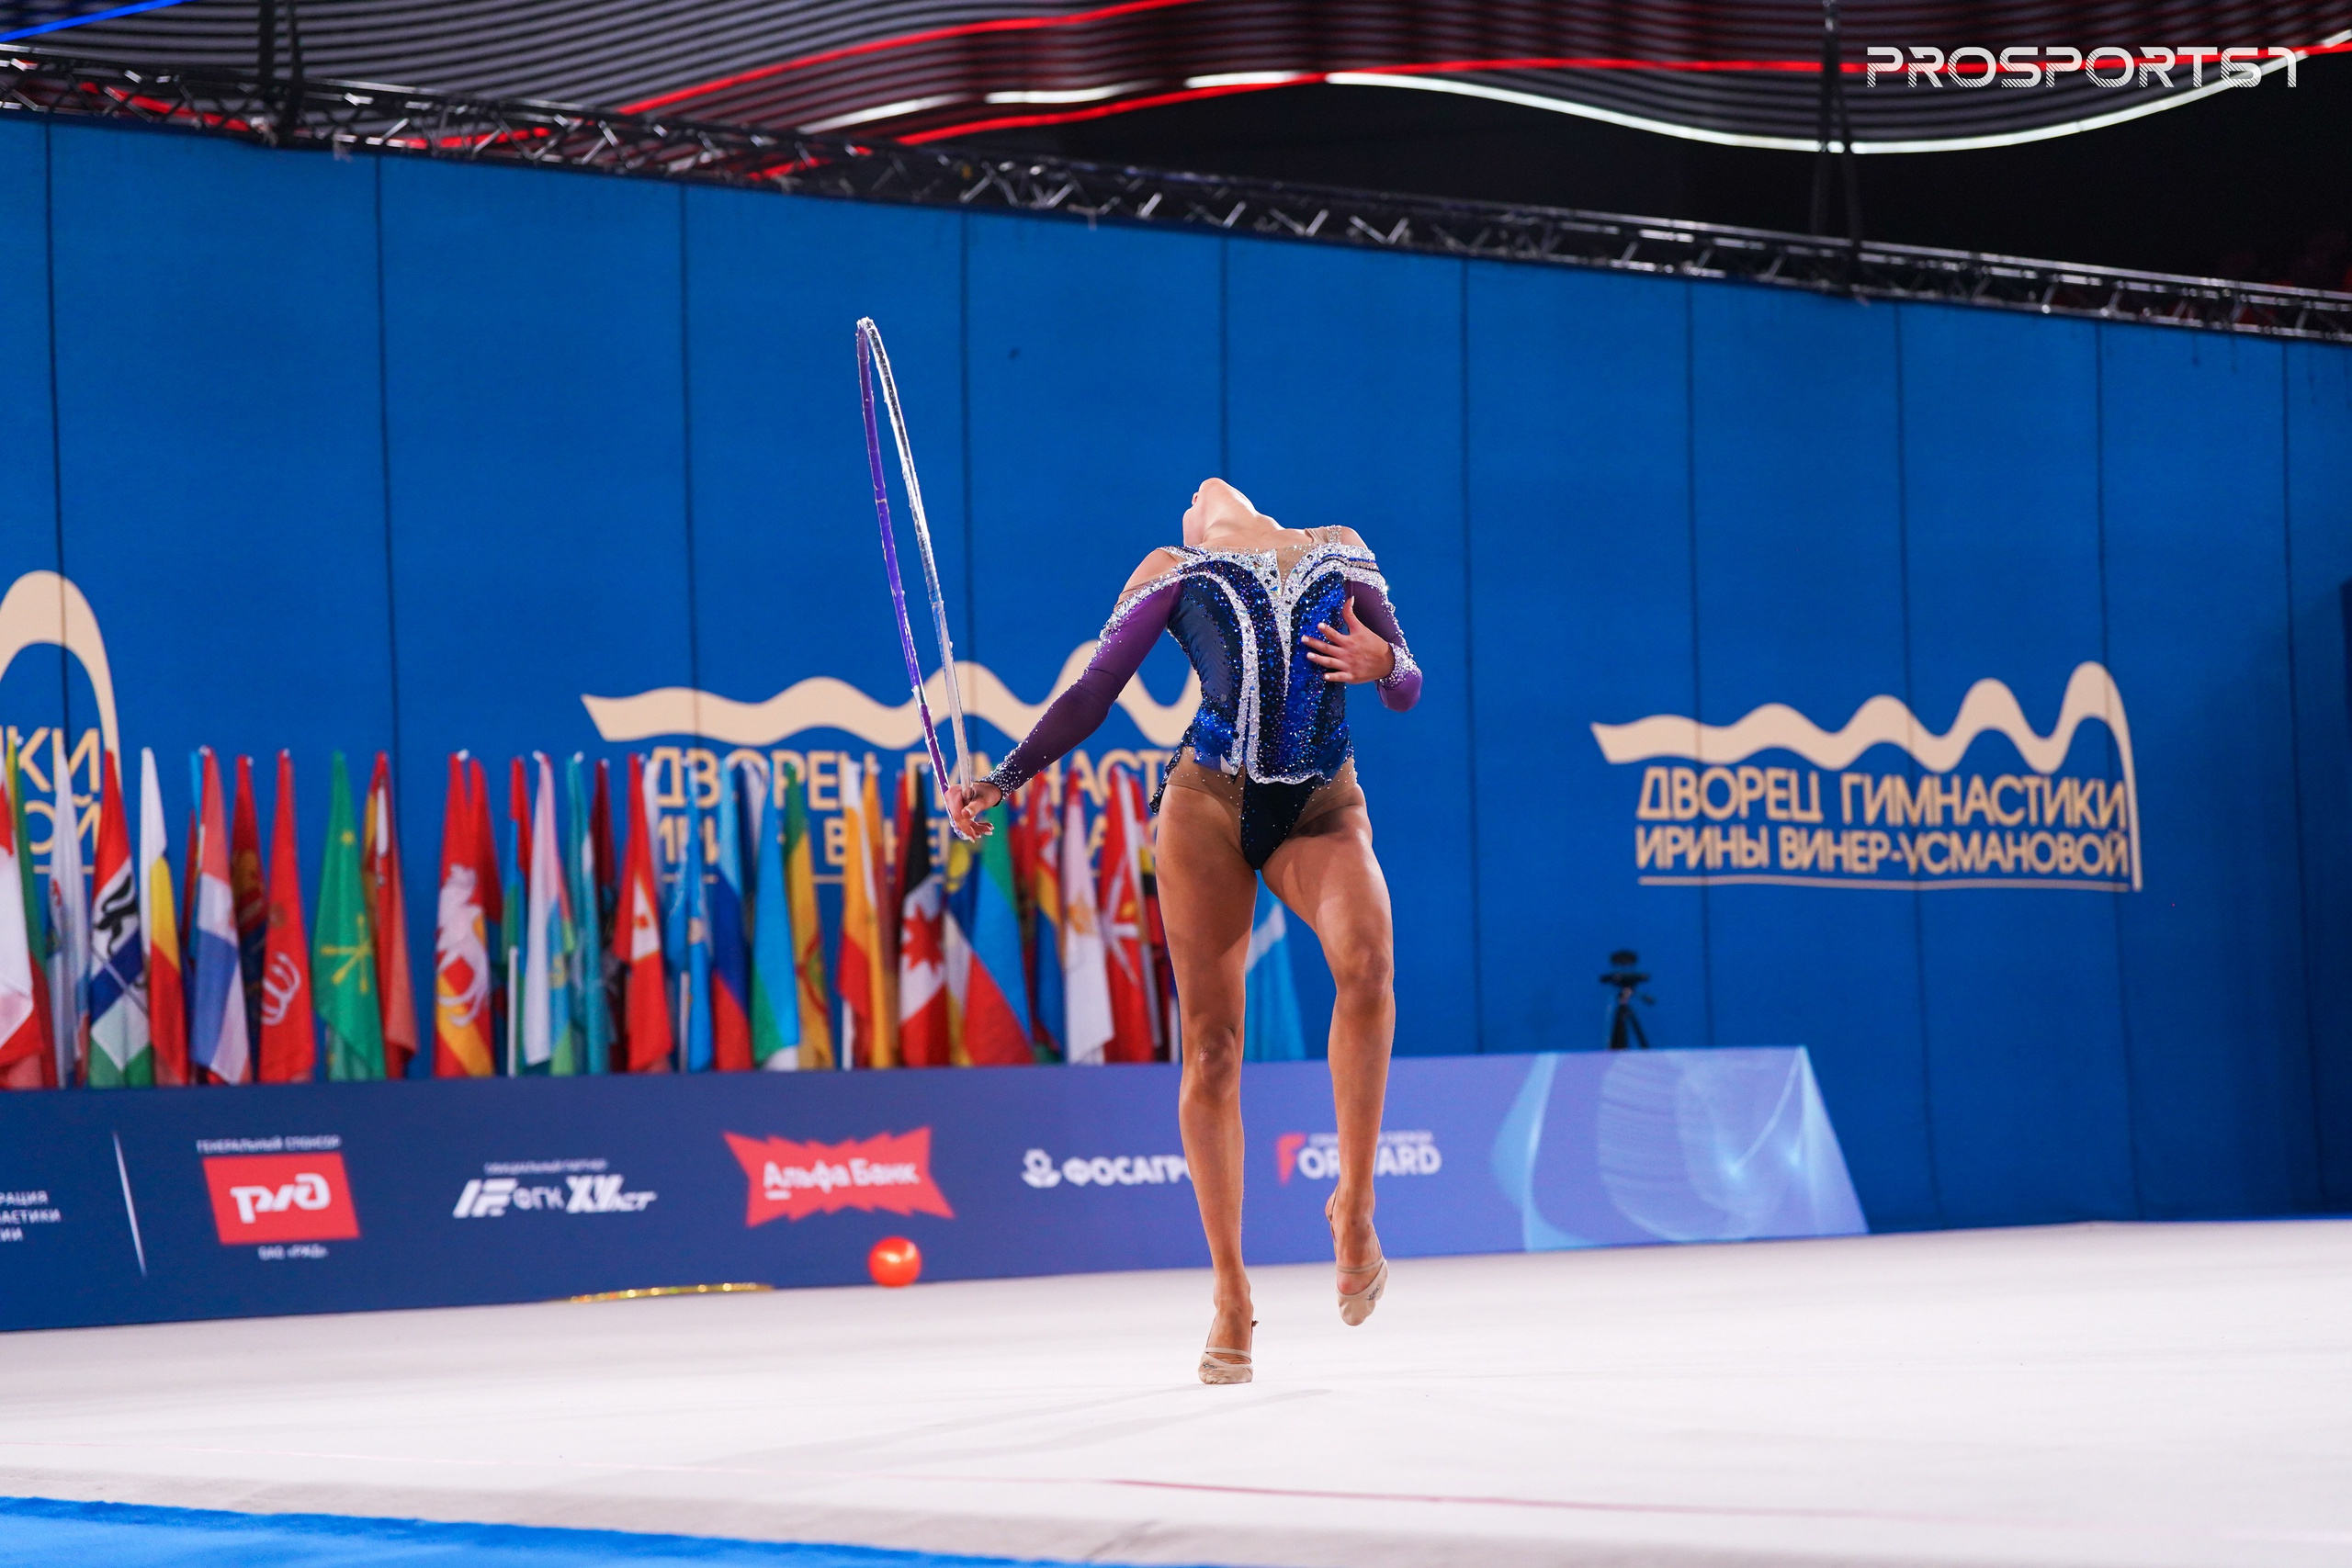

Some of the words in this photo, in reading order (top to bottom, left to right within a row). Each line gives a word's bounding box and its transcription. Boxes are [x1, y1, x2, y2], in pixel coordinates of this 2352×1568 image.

[1636, 766, 1823, 823] ДВОРЕЦ
[1840, 773, 2128, 829] ГИМНАСТИКИ
[1636, 825, 1770, 870] ИРИНЫ
[1779, 827, 2130, 877] ВИНЕР-УСМАНОВОЙ
[763, 1161, 851, 1194] Альфа
[849, 1157, 921, 1187] Банк
[1061, 1155, 1192, 1187] ФОСАГР
[1277, 1133, 1442, 1187] FORARD
